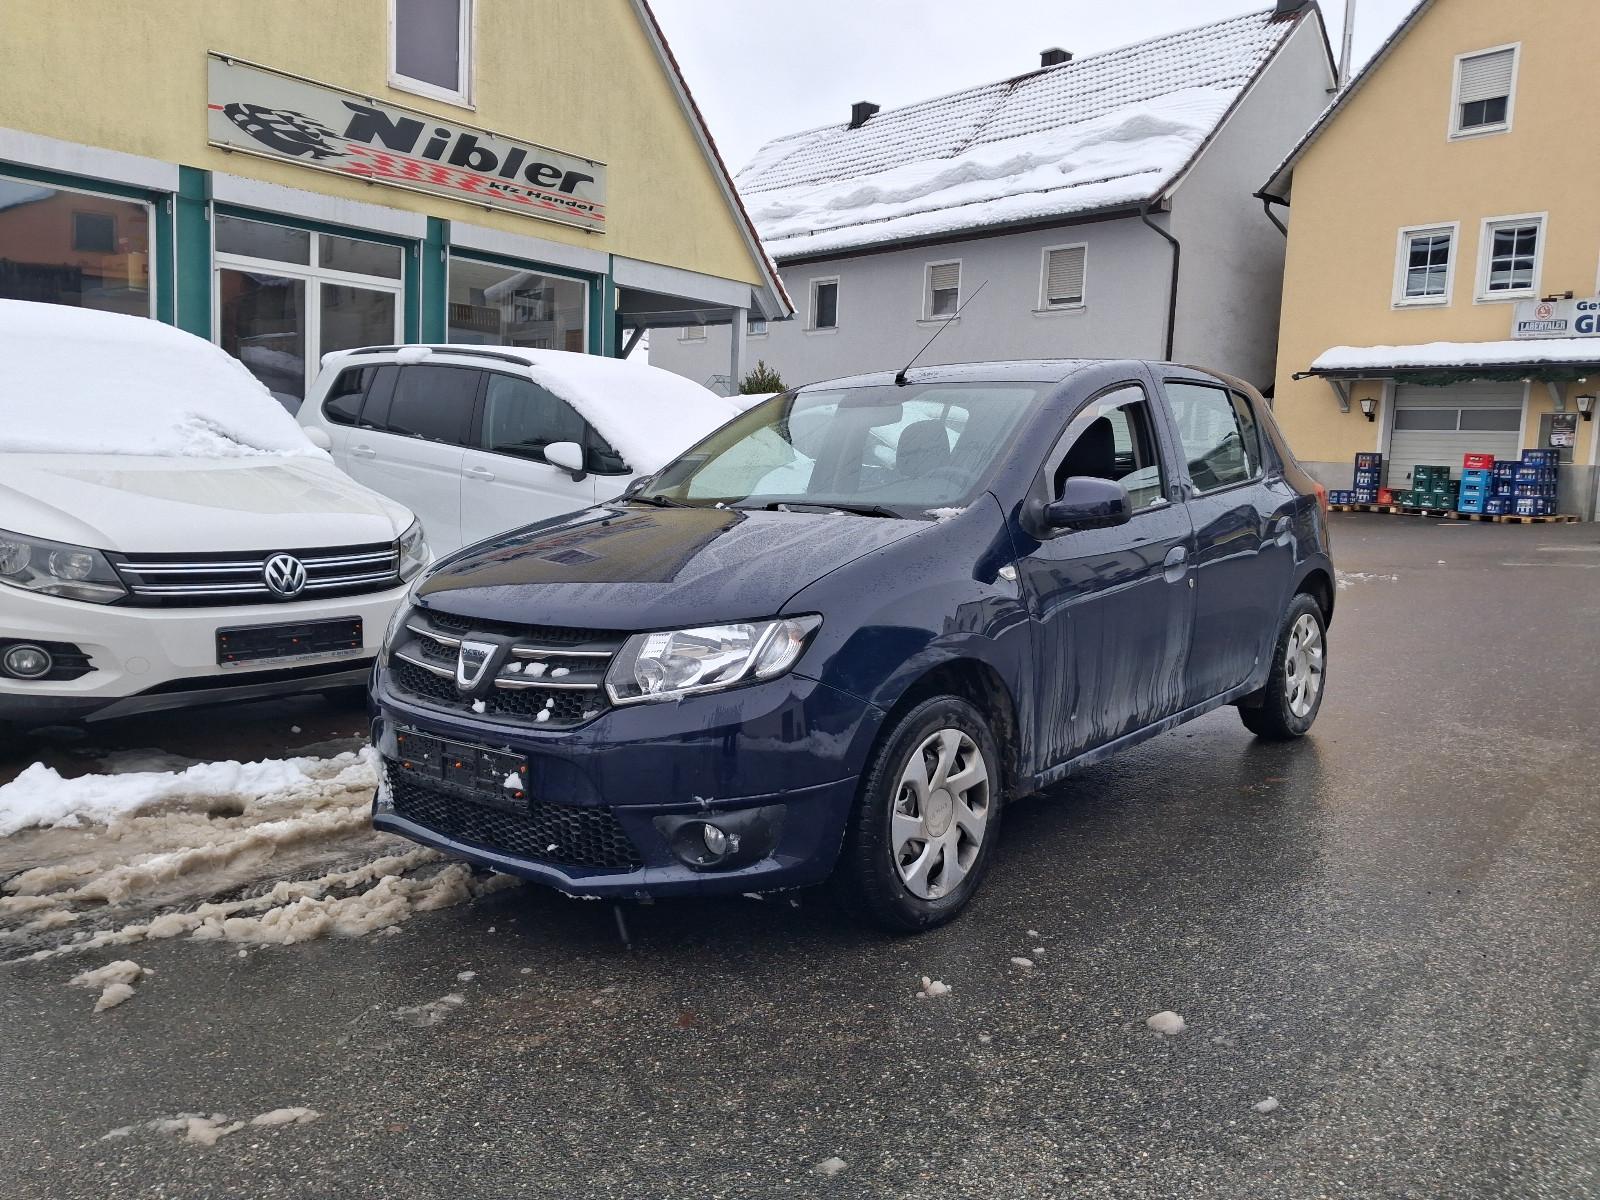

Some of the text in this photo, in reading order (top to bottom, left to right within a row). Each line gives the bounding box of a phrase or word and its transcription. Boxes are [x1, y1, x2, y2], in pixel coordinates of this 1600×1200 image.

[341, 100, 594, 194] Nibler
[526, 190, 594, 212] Handel
[1576, 301, 1600, 311] Ge
